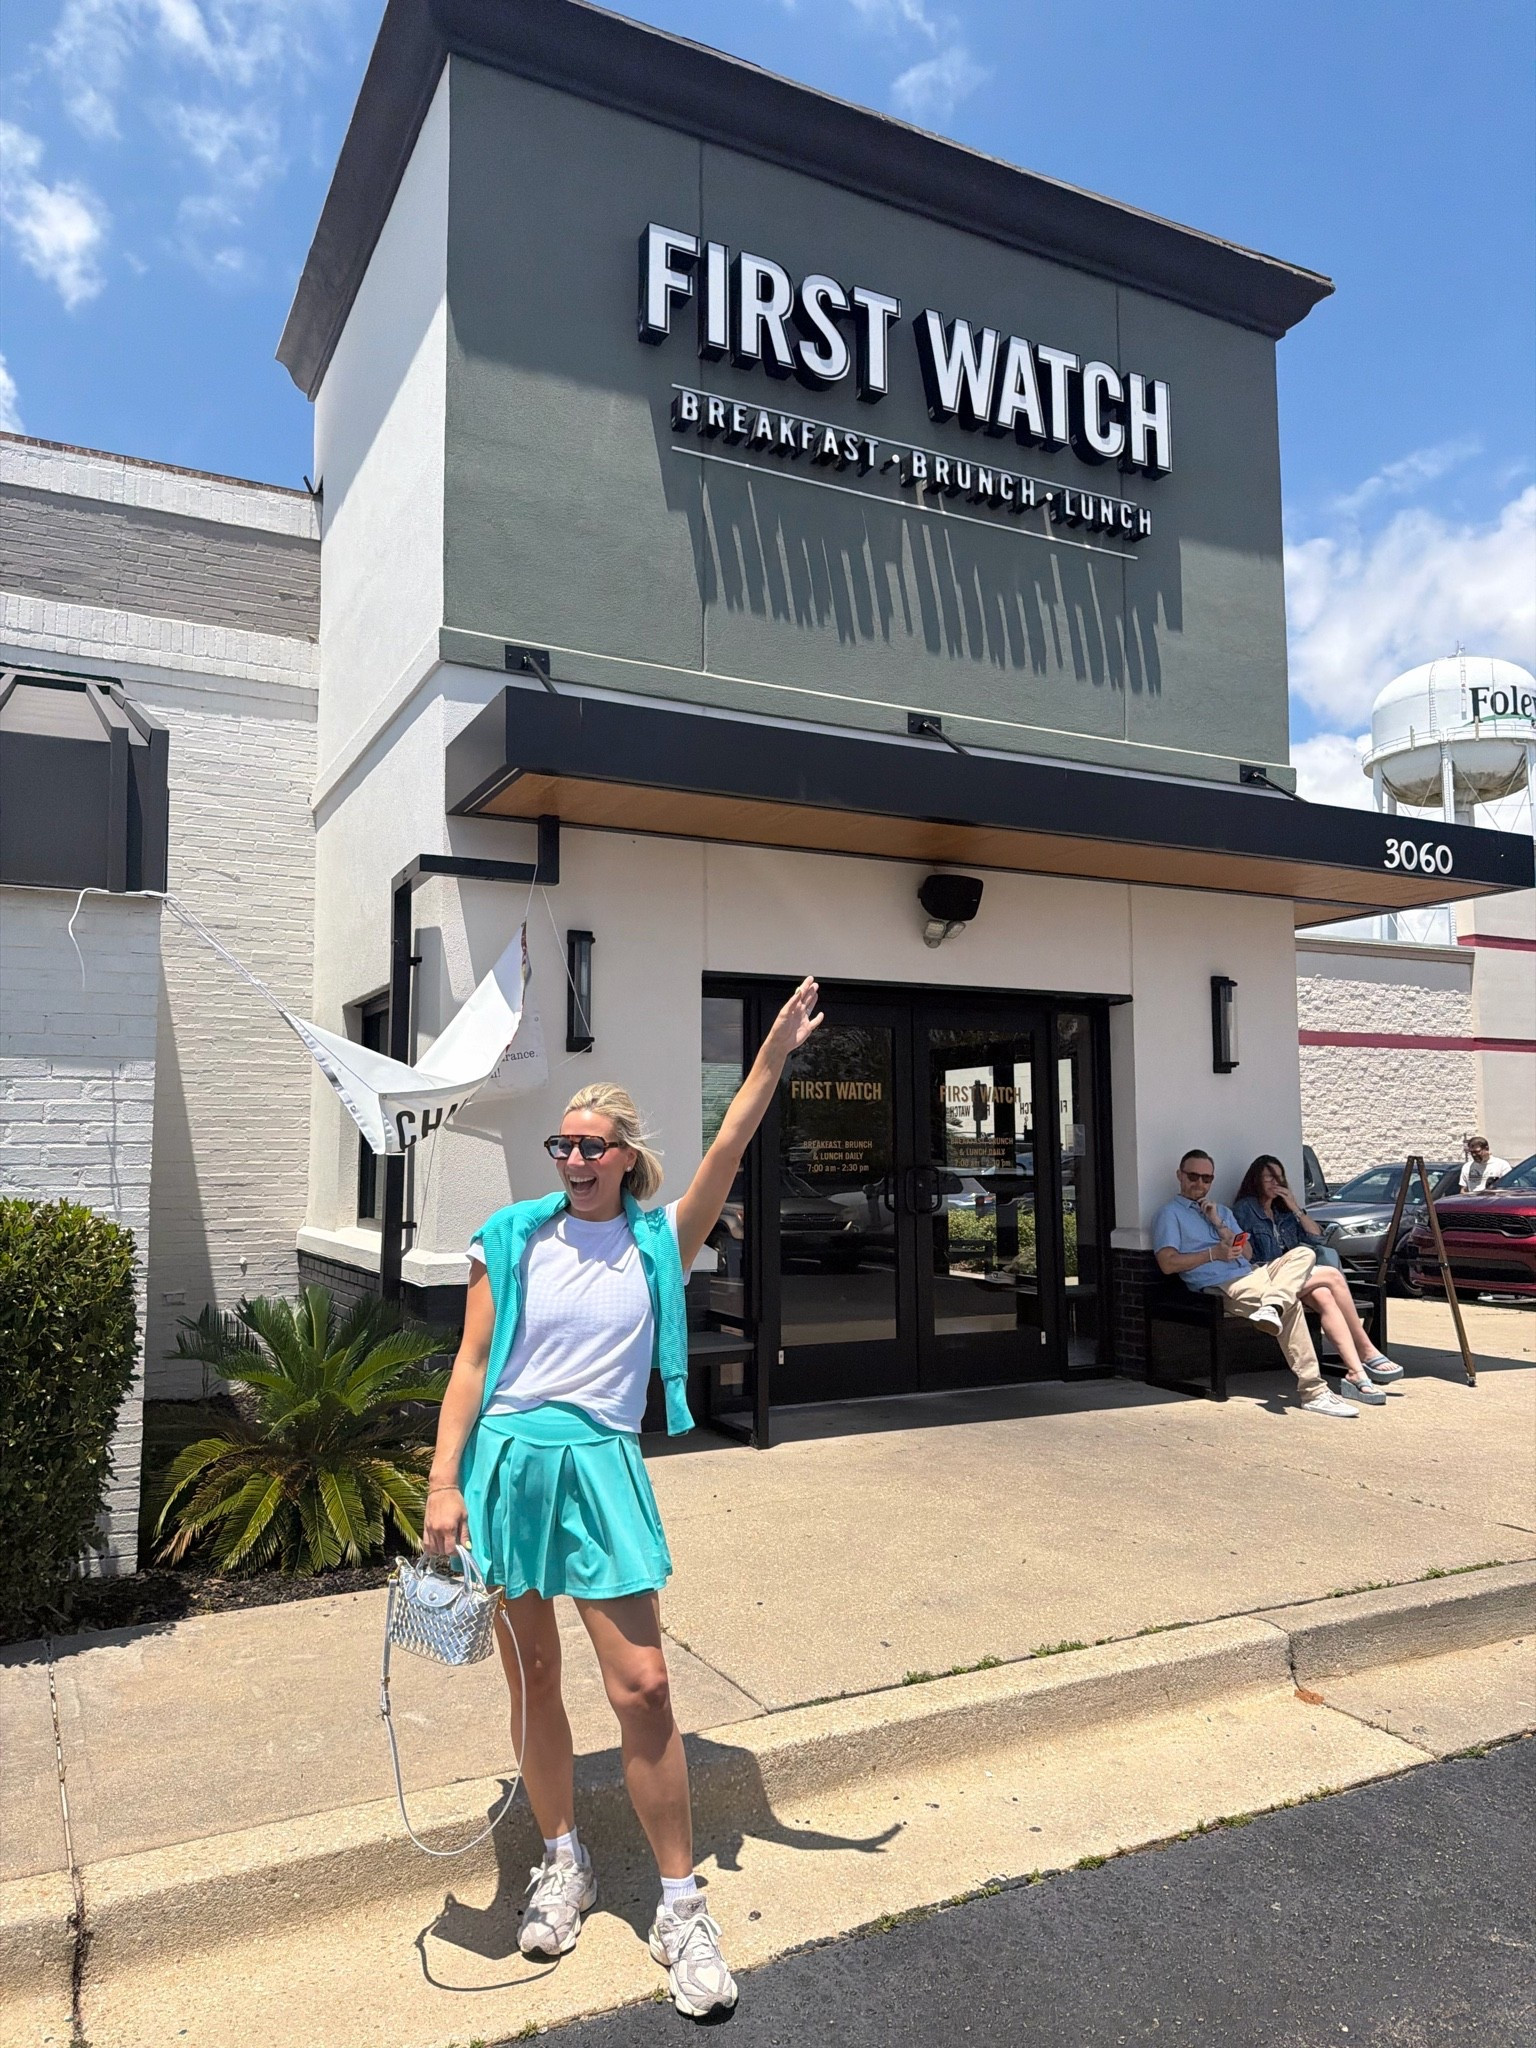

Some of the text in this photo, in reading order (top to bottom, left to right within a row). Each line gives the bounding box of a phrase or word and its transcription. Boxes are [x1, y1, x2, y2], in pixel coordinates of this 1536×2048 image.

[644, 221, 1173, 476] FIRST WATCH
[679, 390, 1151, 536] BREAKFAST BRUNCH LUNCH
[1383, 838, 1453, 875] 3060
[502, 1050, 539, 1062] rance.
[791, 1081, 882, 1100] FIRST WATCH
[939, 1085, 1021, 1104] FIRST WATCH
[844, 1140, 873, 1149] BRUNCH
[813, 1151, 864, 1160] & LUNCH DAILY
[807, 1164, 824, 1173] 7:00
[841, 1163, 858, 1172] 2:30
[860, 1164, 870, 1174] pm
